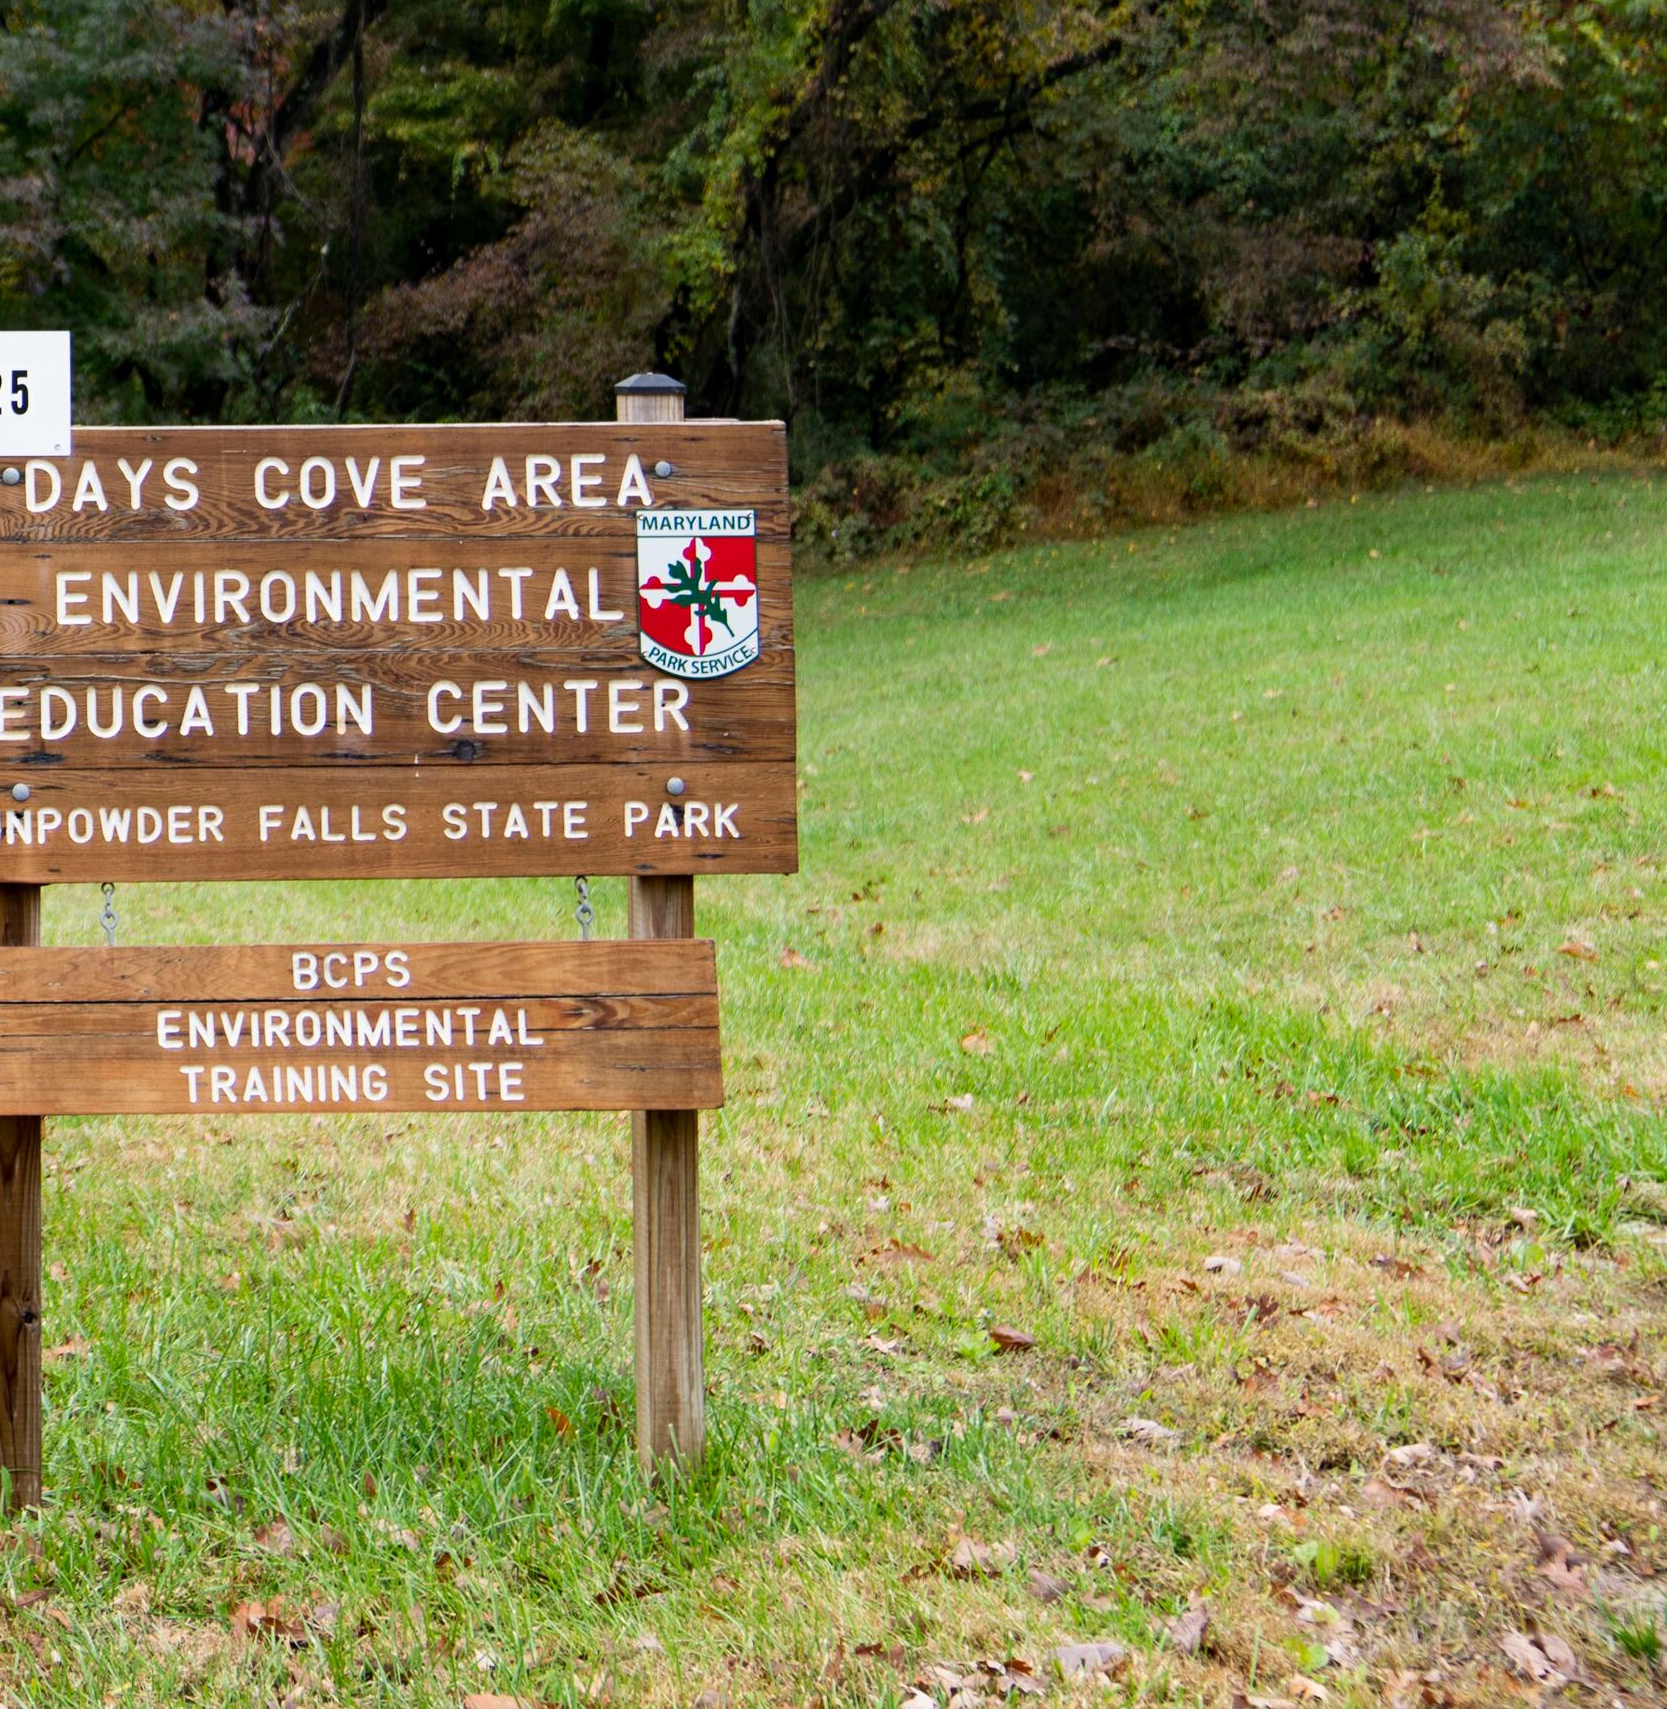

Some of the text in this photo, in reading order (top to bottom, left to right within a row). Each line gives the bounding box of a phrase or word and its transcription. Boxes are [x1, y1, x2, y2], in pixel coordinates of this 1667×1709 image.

[23, 452, 655, 515] DAYS COVE AREA
[641, 515, 751, 531] MARYLAND
[55, 566, 626, 627] ENVIRONMENTAL
[648, 645, 752, 675] PARK SERVICE
[426, 677, 691, 736] CENTER
[258, 803, 408, 843] FALLS
[441, 800, 590, 841] STATE
[623, 800, 741, 840] PARK
[291, 950, 412, 991] BCPS
[156, 1007, 545, 1050] ENVIRONMENTAL
[179, 1062, 525, 1105] TRAINING SITE
